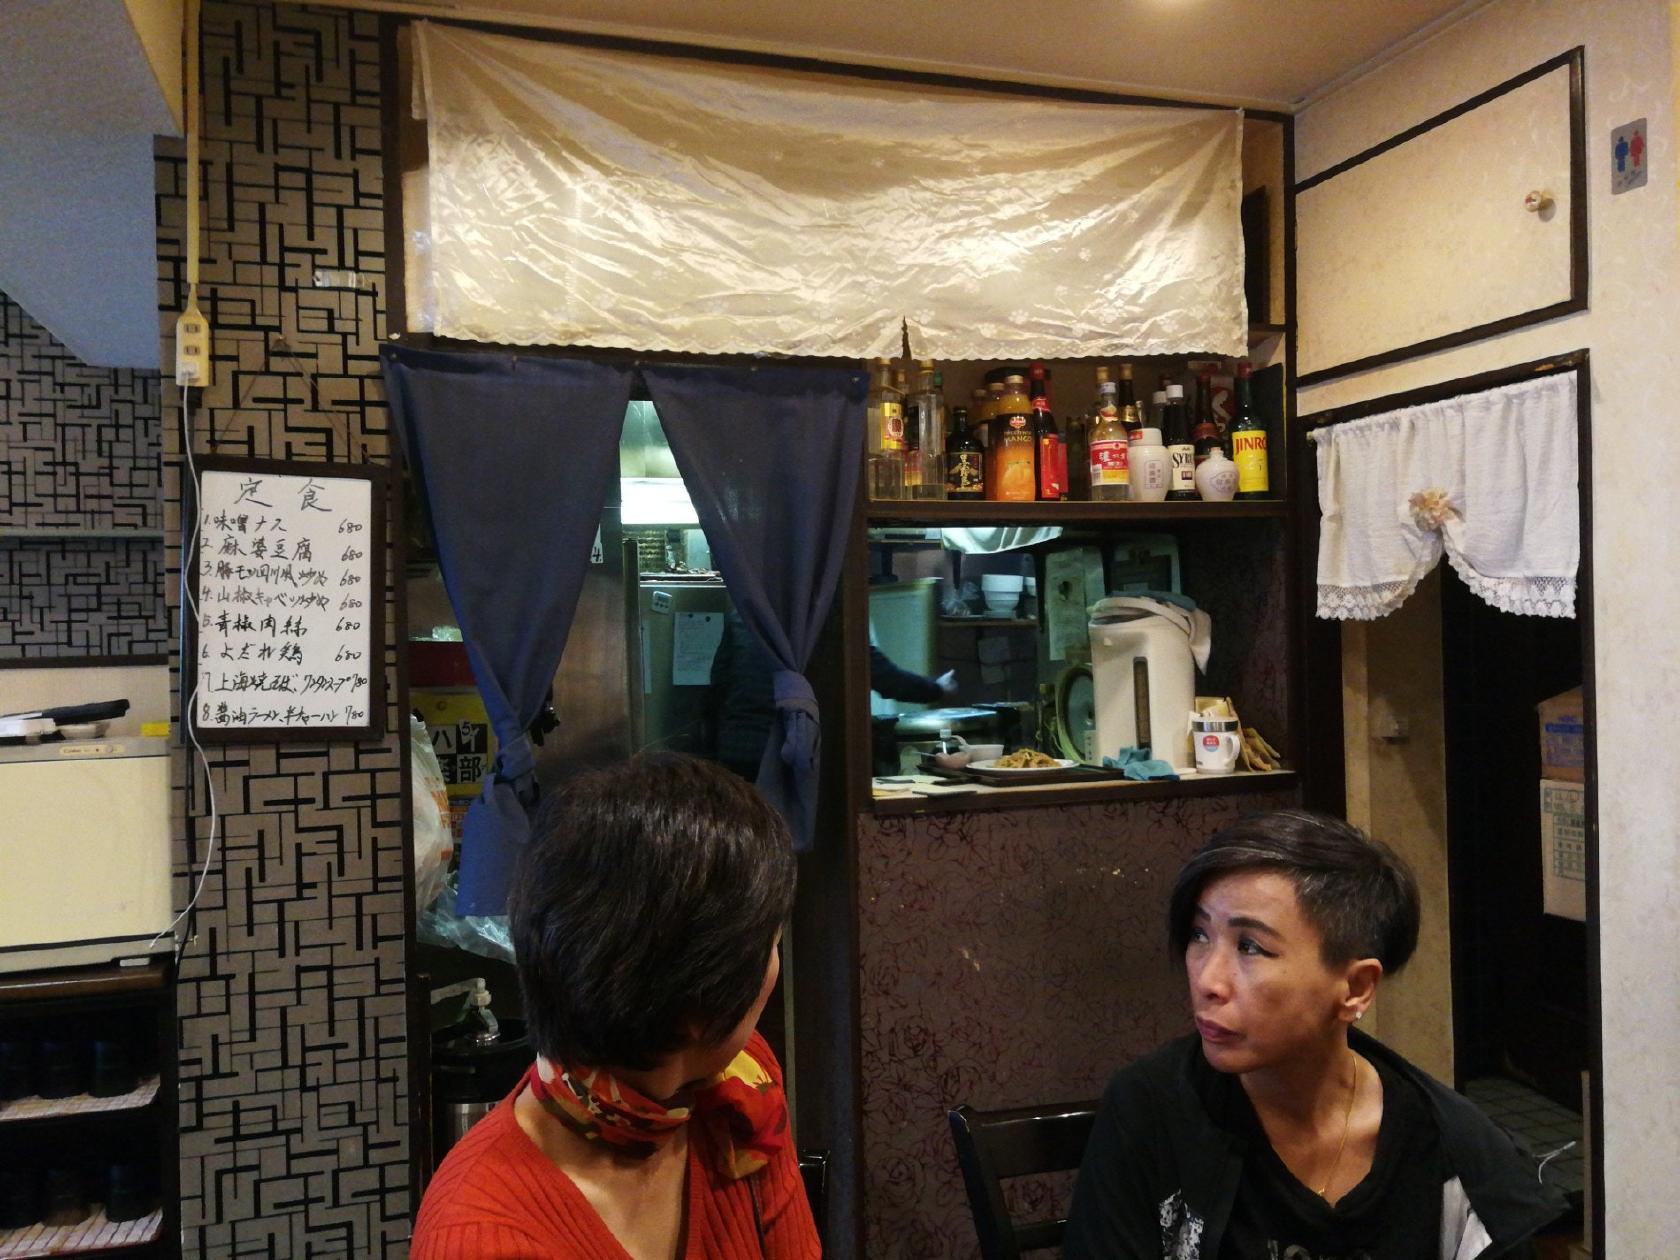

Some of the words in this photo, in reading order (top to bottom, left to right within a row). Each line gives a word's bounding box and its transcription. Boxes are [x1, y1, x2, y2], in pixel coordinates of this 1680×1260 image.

[338, 519, 363, 534] 680
[218, 534, 312, 563] 麻婆豆腐
[341, 545, 363, 561] 680
[339, 569, 361, 586] 680
[339, 593, 362, 612] 680
[335, 616, 361, 632] 680
[335, 644, 361, 662] 680
[345, 705, 364, 725] 780
